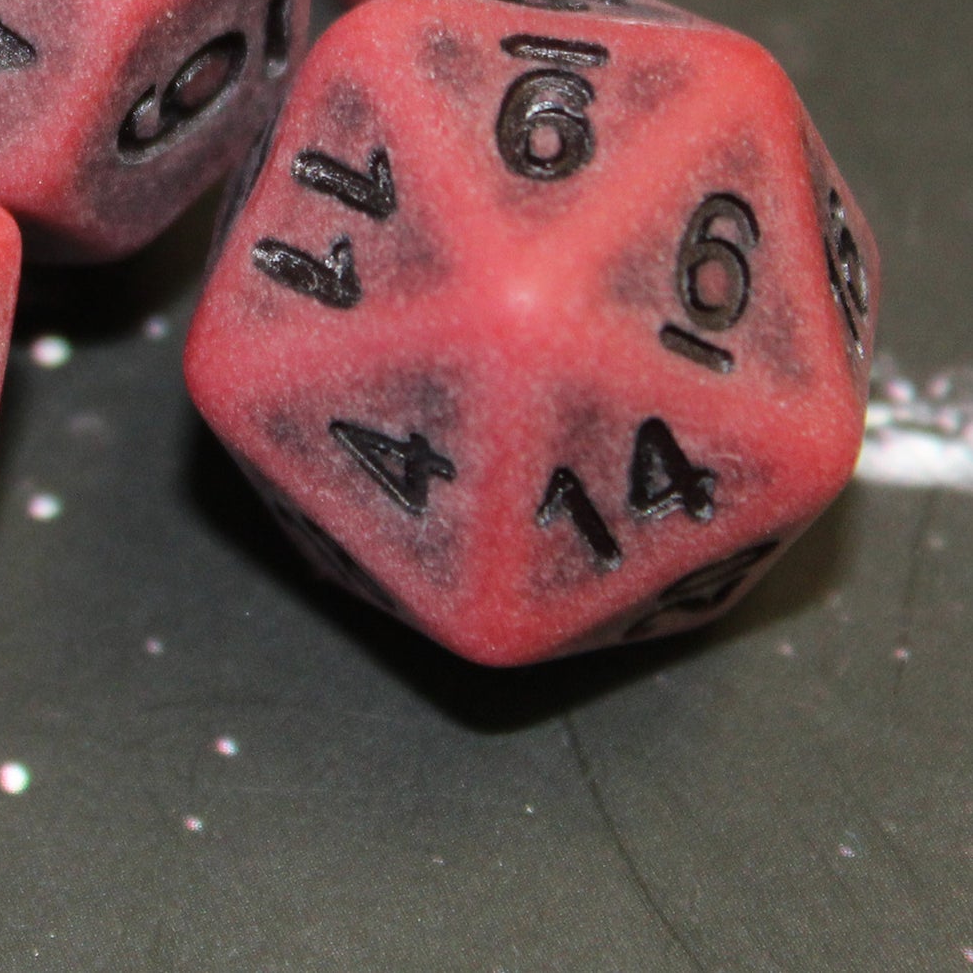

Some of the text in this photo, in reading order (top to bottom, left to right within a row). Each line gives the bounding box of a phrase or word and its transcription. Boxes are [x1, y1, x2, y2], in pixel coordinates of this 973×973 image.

[251, 146, 398, 310] 11
[329, 419, 456, 517] 4
[535, 417, 716, 572] 14
